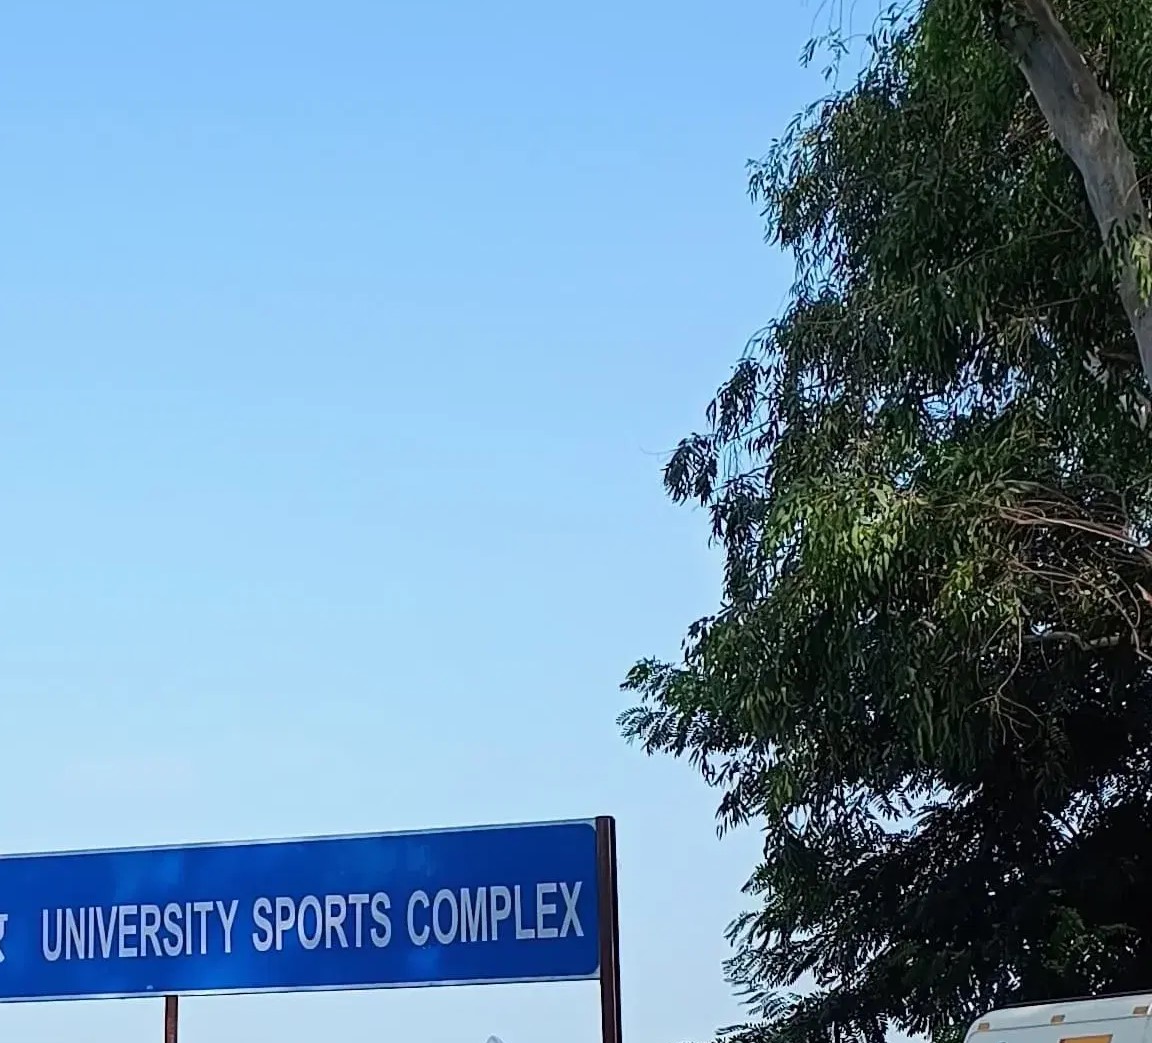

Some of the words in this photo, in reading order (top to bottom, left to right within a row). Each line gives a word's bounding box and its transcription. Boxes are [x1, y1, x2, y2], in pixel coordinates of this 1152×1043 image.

[42, 899, 239, 961] UNIVERSITY
[252, 891, 392, 951] SPORTS
[407, 881, 585, 946] COMPLEX
